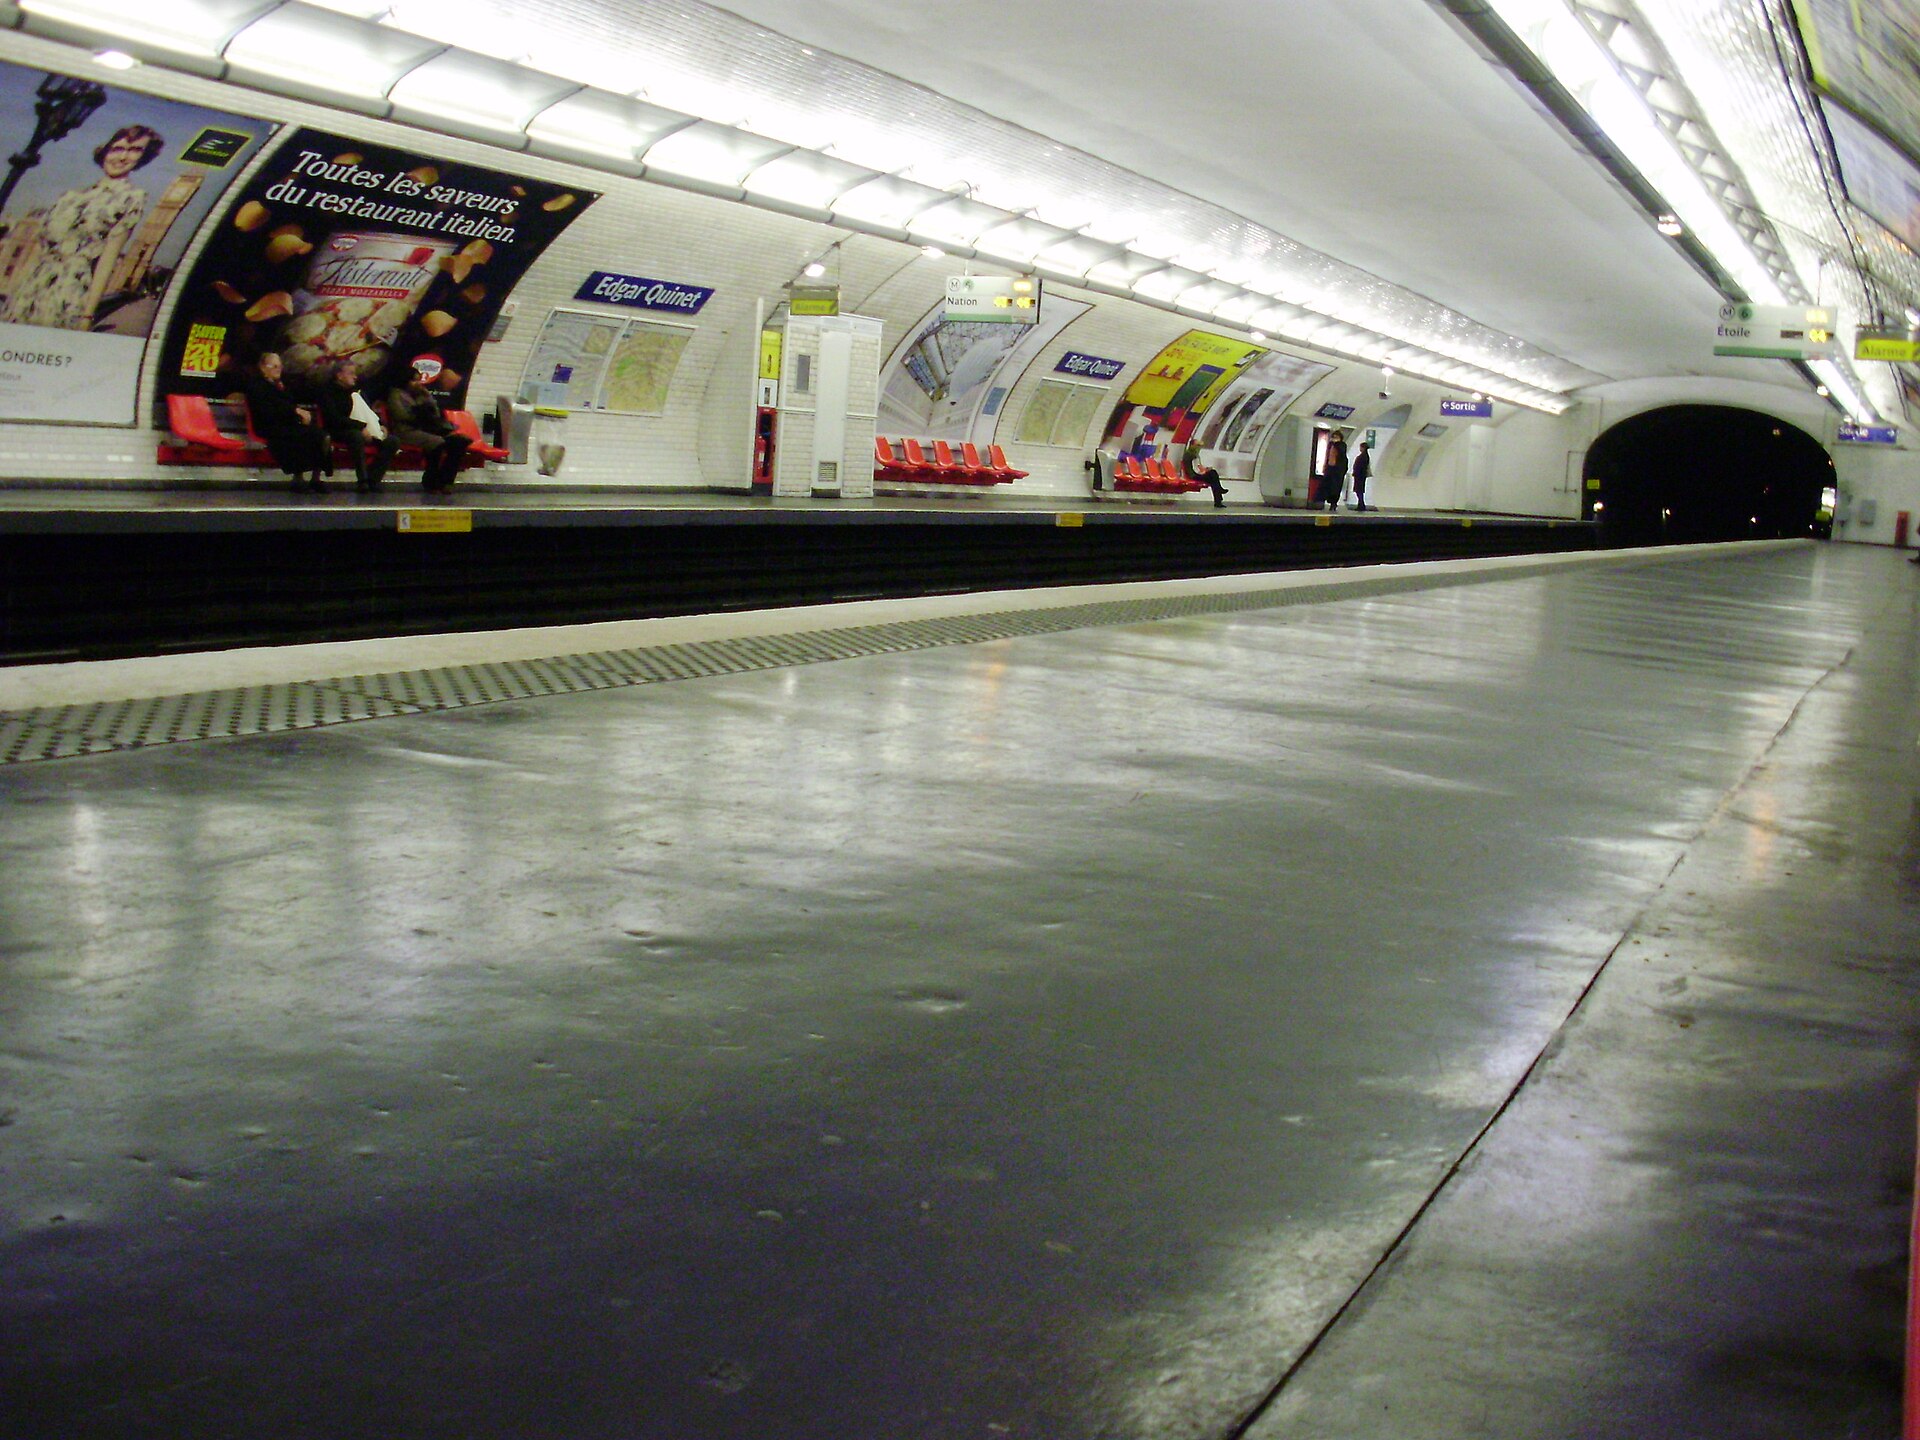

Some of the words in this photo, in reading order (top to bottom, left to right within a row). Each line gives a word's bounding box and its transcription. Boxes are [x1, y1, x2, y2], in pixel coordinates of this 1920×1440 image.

[291, 151, 385, 189] Toutes
[383, 172, 426, 197] les
[424, 185, 519, 216] saveurs
[265, 179, 307, 206] du
[305, 191, 443, 230] restaurant
[440, 213, 514, 244] italien.
[593, 276, 647, 302] Edgar
[644, 284, 702, 308] Quinet
[947, 296, 978, 306] Nation
[1717, 324, 1751, 338] Étoile
[1065, 355, 1092, 372] Edgar
[1450, 402, 1476, 411] Sortie
